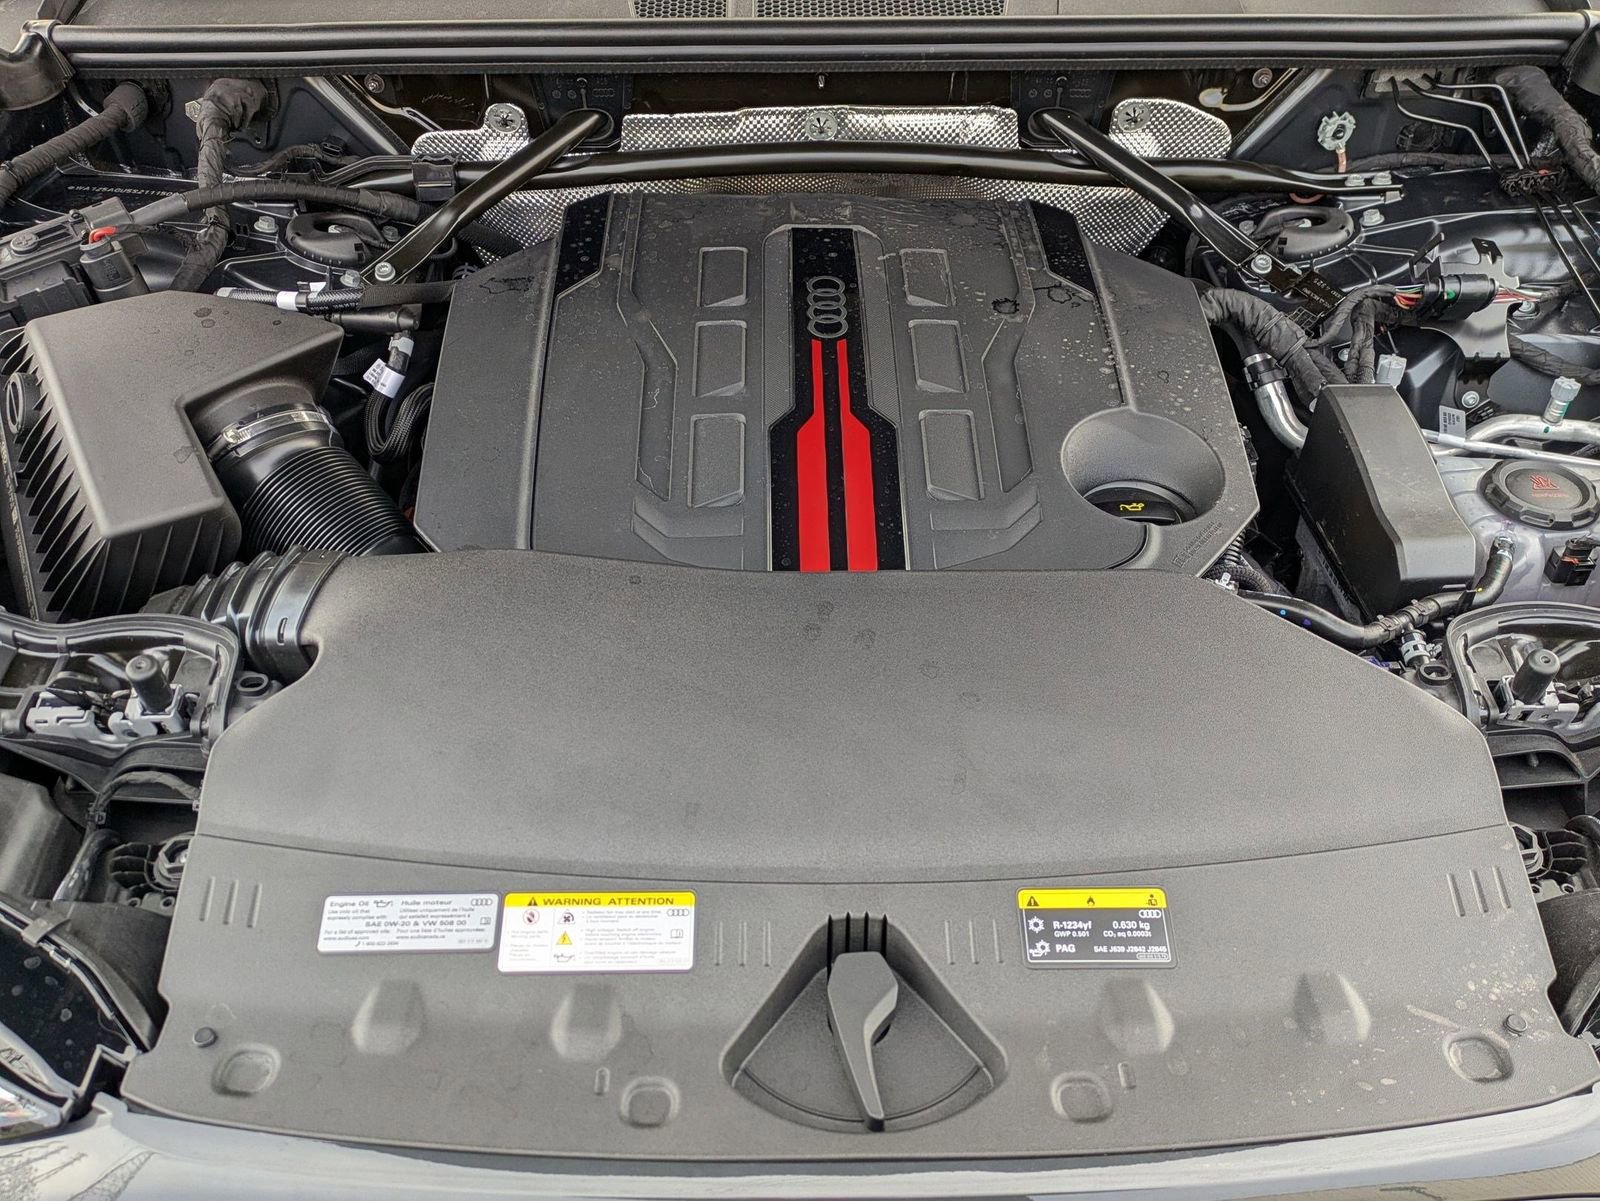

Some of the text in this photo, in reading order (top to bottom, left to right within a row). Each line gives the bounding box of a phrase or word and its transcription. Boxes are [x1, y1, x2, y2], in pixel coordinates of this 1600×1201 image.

[543, 897, 674, 906] WARNING ATTENTION
[1052, 920, 1092, 930] R-1234yf
[1112, 920, 1151, 930] 0.630 kg
[1055, 944, 1076, 953] PAG
